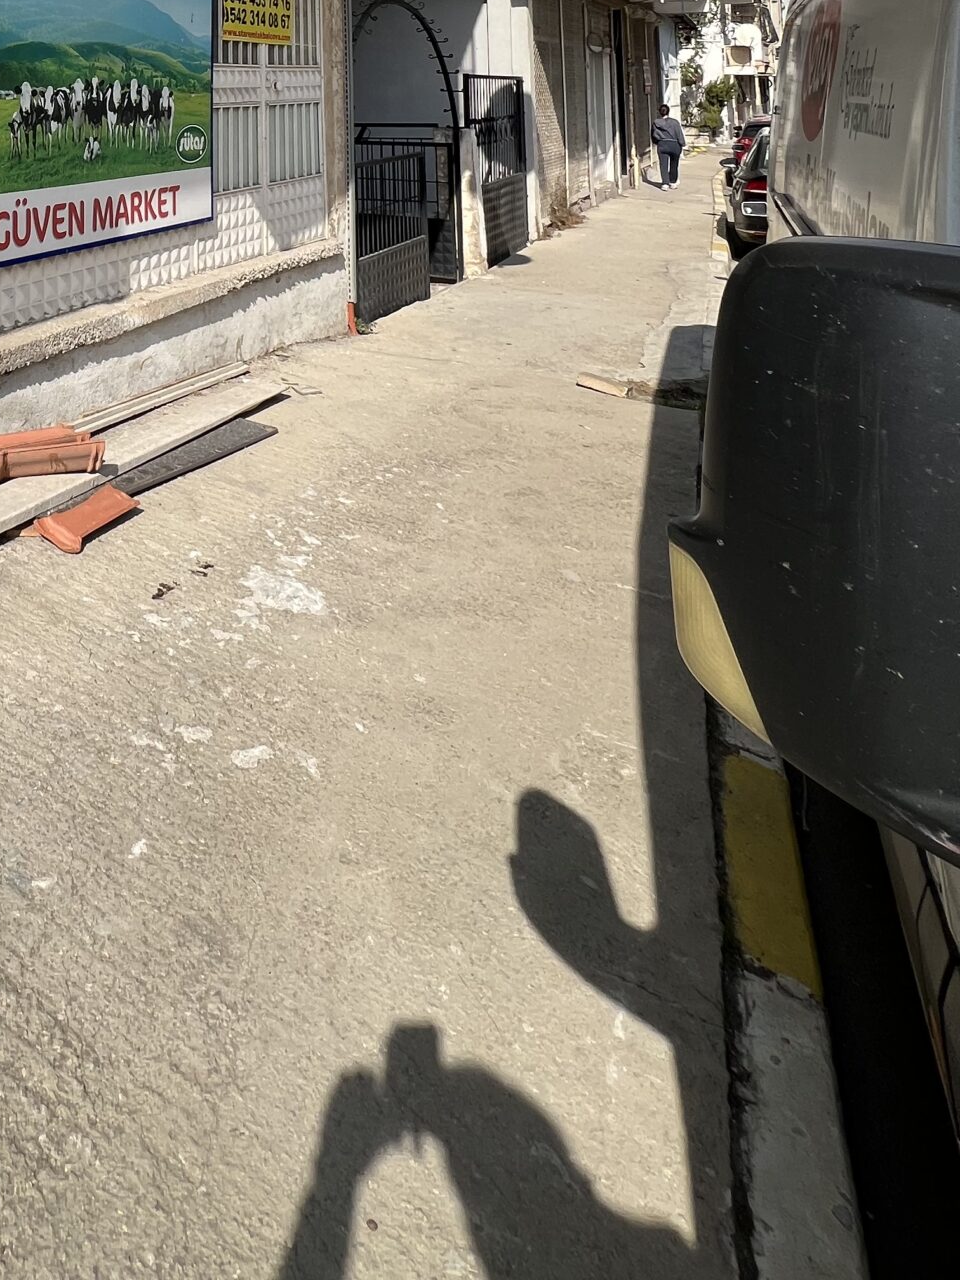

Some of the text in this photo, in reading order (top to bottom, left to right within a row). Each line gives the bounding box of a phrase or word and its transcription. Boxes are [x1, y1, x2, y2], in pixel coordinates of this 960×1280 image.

[249, 9, 266, 27] 314
[268, 12, 279, 29] 08
[280, 13, 291, 30] 67
[92, 184, 181, 233] MARKET
